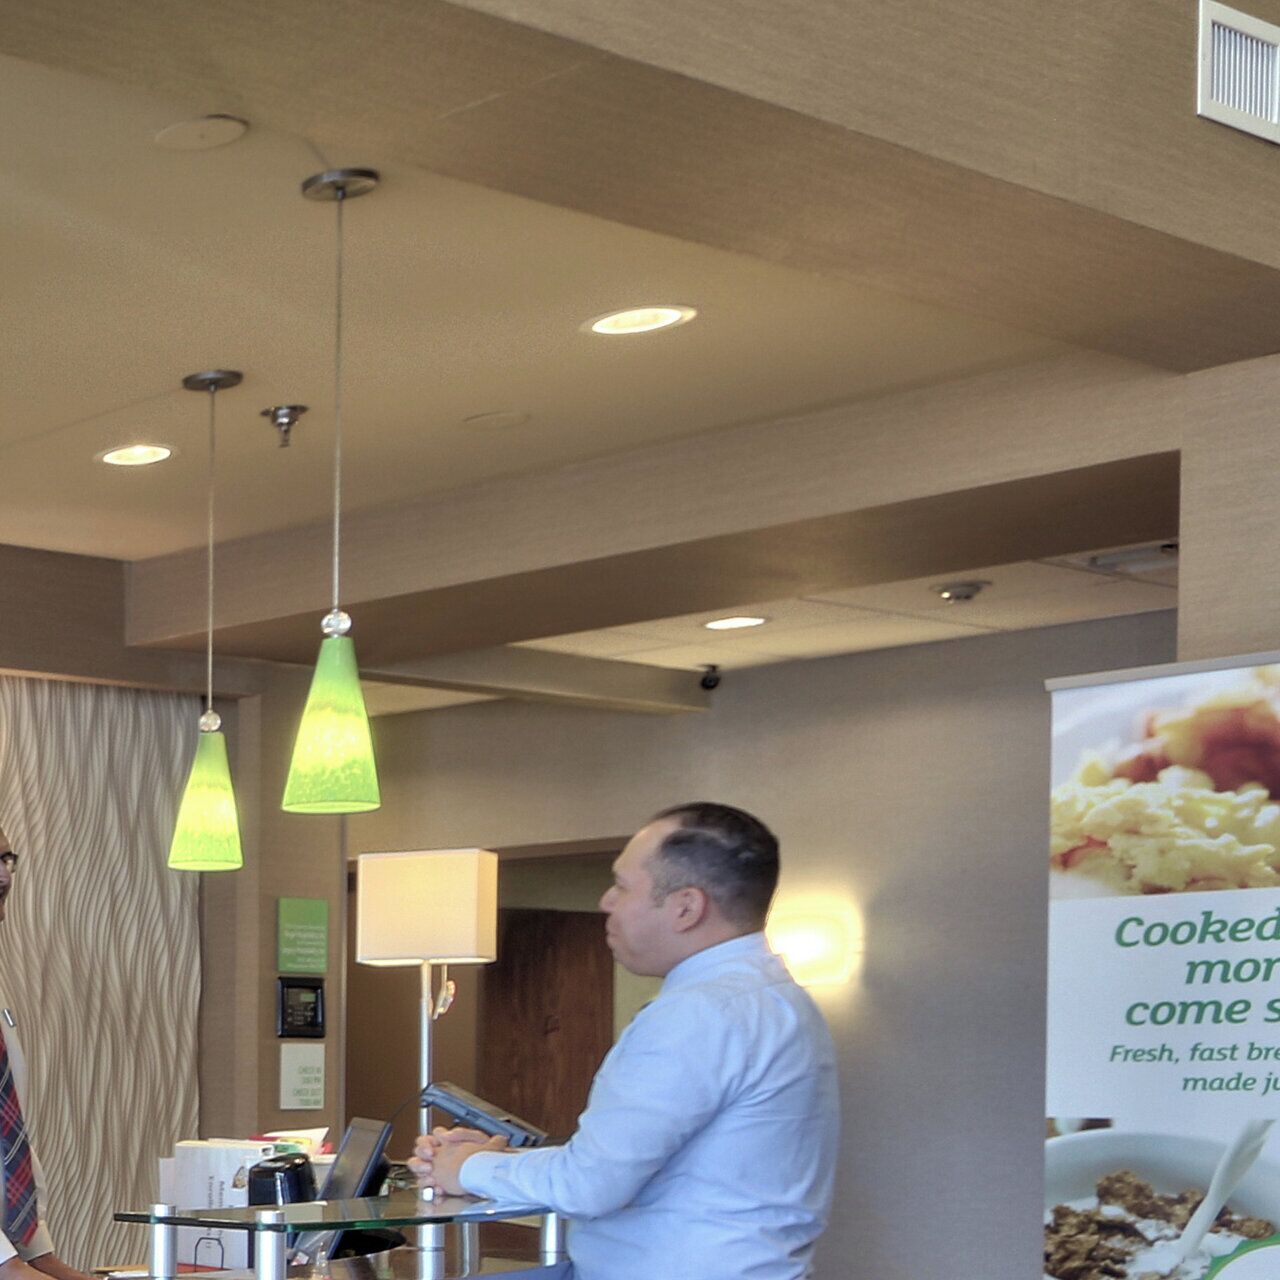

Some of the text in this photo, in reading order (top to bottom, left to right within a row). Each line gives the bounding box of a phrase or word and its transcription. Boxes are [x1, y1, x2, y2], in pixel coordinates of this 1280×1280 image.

[1115, 906, 1280, 948] Cooked
[1125, 998, 1252, 1026] come
[1109, 1043, 1180, 1064] Fresh,
[1190, 1042, 1239, 1062] fast
[1182, 1071, 1257, 1092] made
